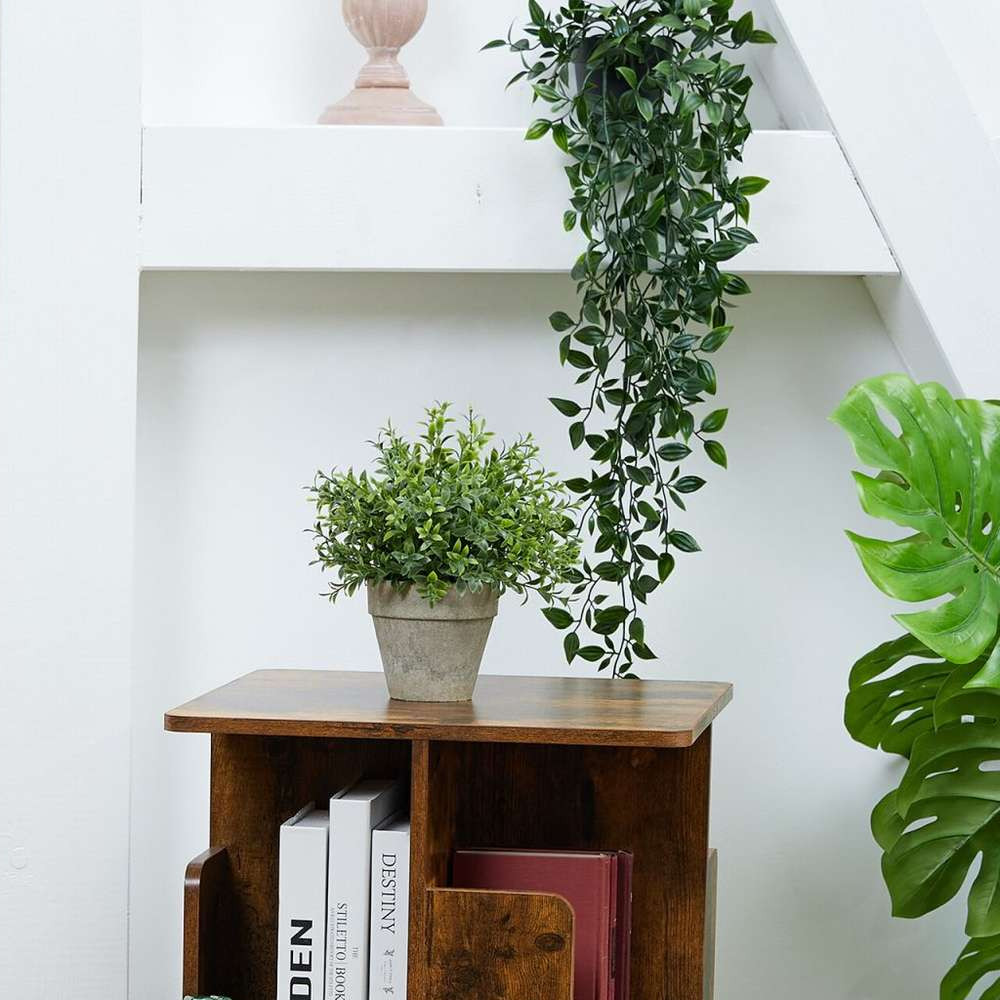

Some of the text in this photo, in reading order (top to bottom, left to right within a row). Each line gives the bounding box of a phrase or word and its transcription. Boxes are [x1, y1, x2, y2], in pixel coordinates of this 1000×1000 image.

[381, 854, 397, 934] DESTINY
[334, 903, 347, 1000] STILETTO BOOK
